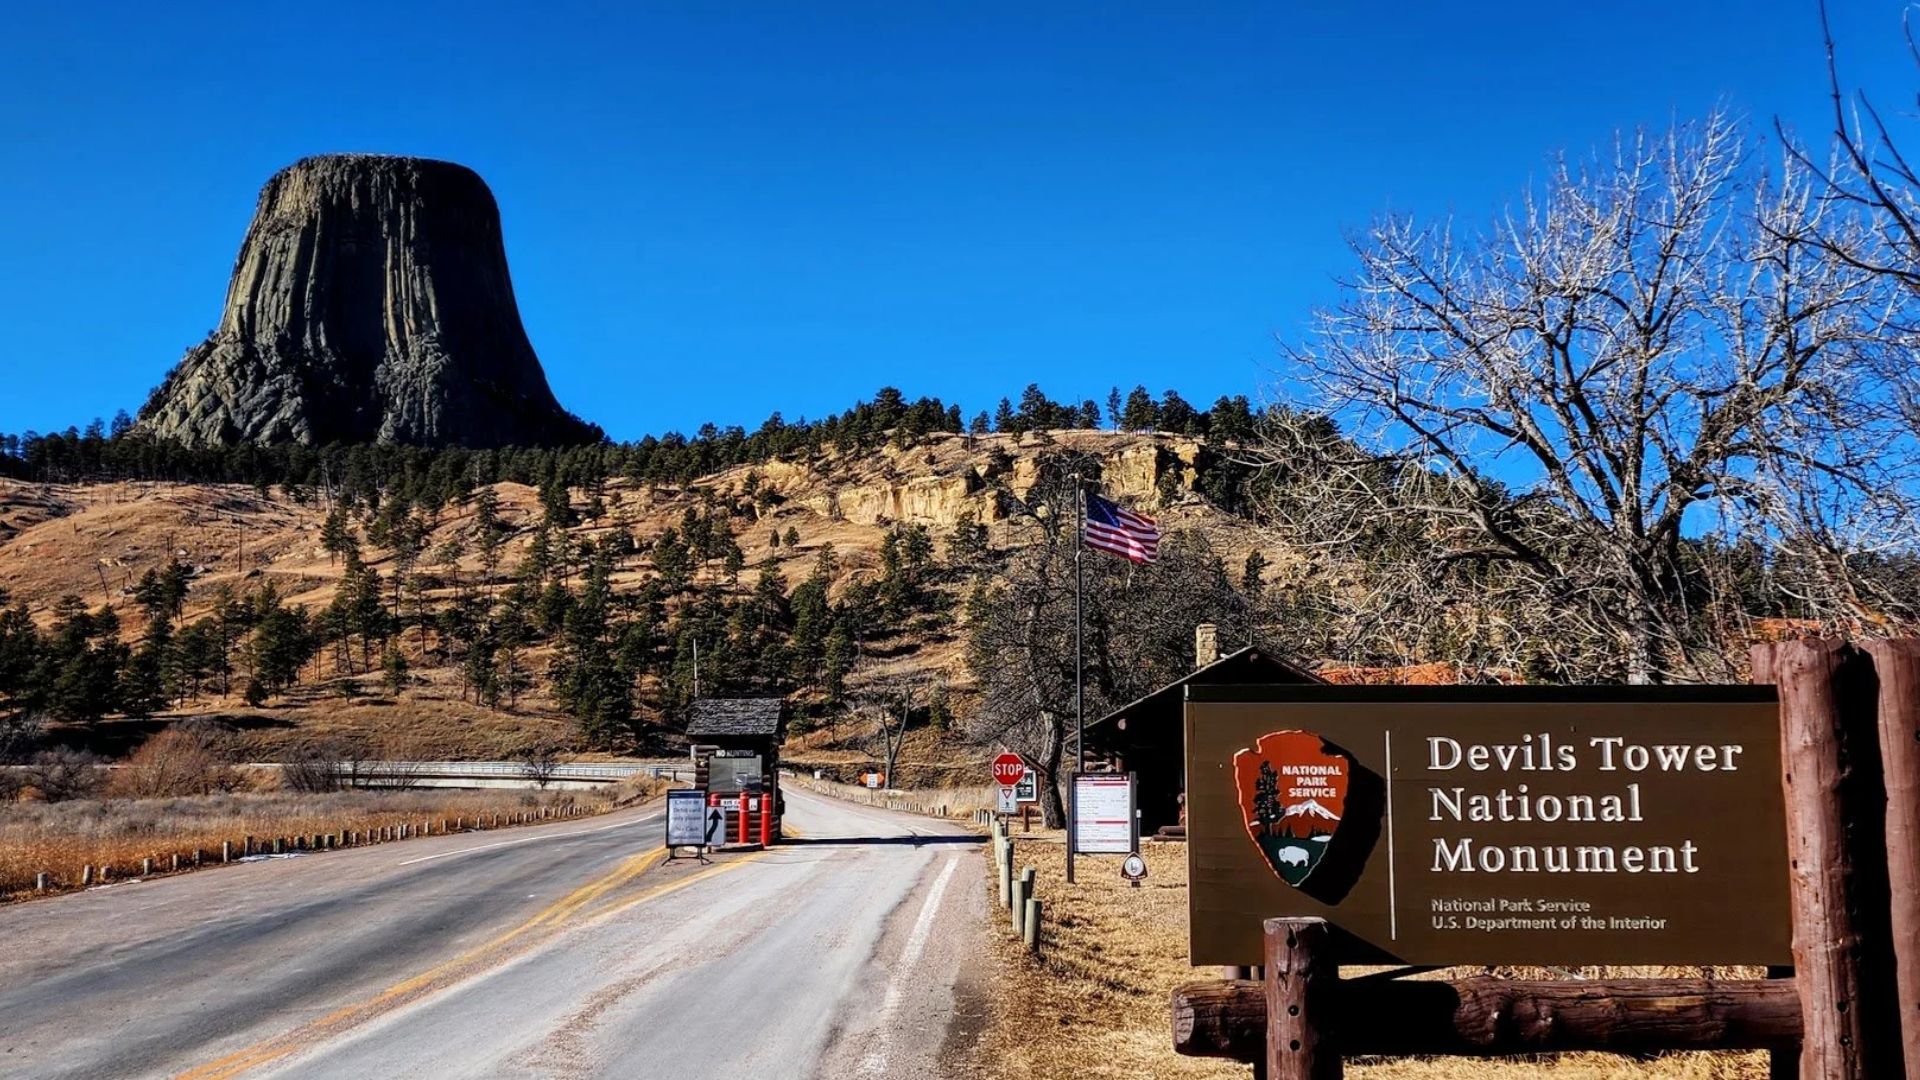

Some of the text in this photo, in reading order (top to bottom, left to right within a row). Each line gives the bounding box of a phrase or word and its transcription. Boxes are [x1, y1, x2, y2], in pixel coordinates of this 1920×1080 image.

[1427, 733, 1742, 771] Devils Tower
[995, 764, 1022, 775] STOP
[1283, 766, 1341, 775] NATIONAL
[1297, 777, 1327, 786] PARK
[1289, 788, 1336, 797] SERVICE
[1429, 784, 1643, 821] National
[1431, 838, 1699, 872] Monument
[1432, 899, 1590, 911] National Park Service
[1433, 916, 1666, 931] U.S. Department of the Interior
